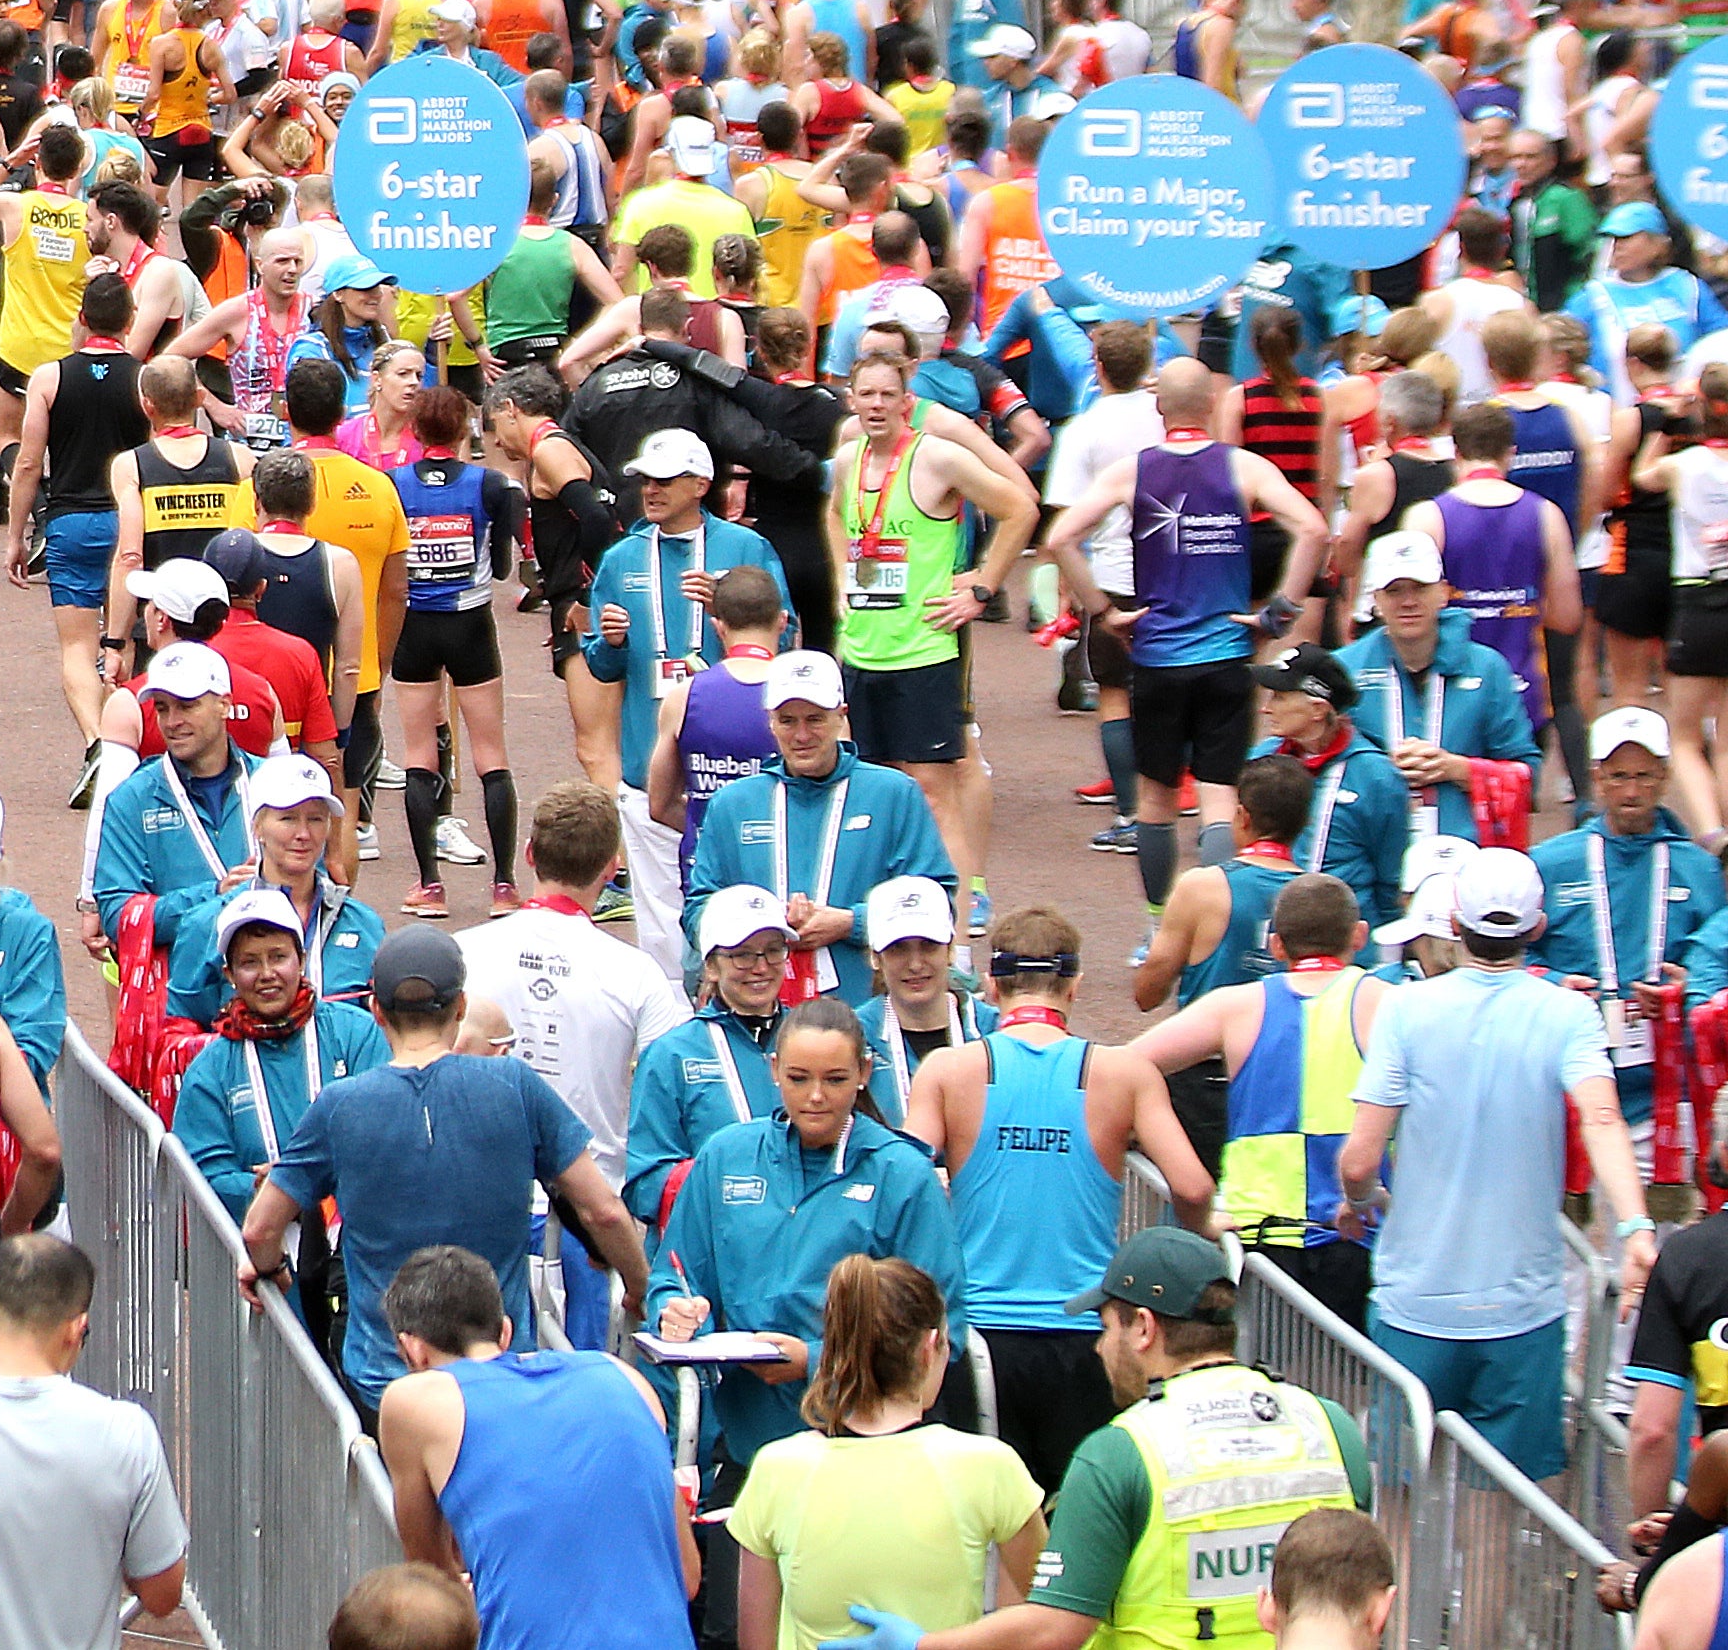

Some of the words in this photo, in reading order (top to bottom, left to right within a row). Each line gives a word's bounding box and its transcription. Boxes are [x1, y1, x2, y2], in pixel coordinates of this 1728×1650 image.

[1348, 82, 1400, 95] ABBOTT
[421, 95, 468, 108] ABBOTT
[1348, 93, 1397, 106] WORLD
[421, 107, 465, 120] WORLD
[1148, 110, 1204, 123] ABBOTT
[1348, 104, 1427, 117] MARATHON
[421, 119, 493, 132] MARATHON
[1148, 122, 1200, 134] WORLD
[1348, 115, 1406, 128] MAJORS
[421, 131, 474, 145] MAJORS
[1148, 133, 1232, 146] MARATHON
[1148, 144, 1207, 158] MAJORS
[1303, 144, 1415, 181] 6-star
[379, 160, 481, 200] 6-star
[1066, 175, 1126, 204] Run
[1132, 184, 1147, 204] a
[1154, 176, 1247, 213] Major,
[1291, 192, 1432, 227] finisher
[30, 204, 82, 231] BRODIE
[369, 211, 497, 251] finisher
[1047, 207, 1130, 238] Claim
[1134, 216, 1202, 247] your
[1205, 209, 1266, 239] Star
[995, 237, 1053, 258] ABL
[1080, 268, 1228, 310] AbbottWMM.com
[154, 492, 225, 510] WINCHESTER
[343, 492, 372, 501] adidas
[431, 518, 470, 533] money
[1184, 513, 1242, 529] Meningitis
[1184, 528, 1236, 541] Research
[417, 543, 458, 563] 686
[1184, 542, 1244, 555] Foundation
[996, 1125, 1071, 1155] FELIPE
[1195, 1542, 1277, 1580] NUR
